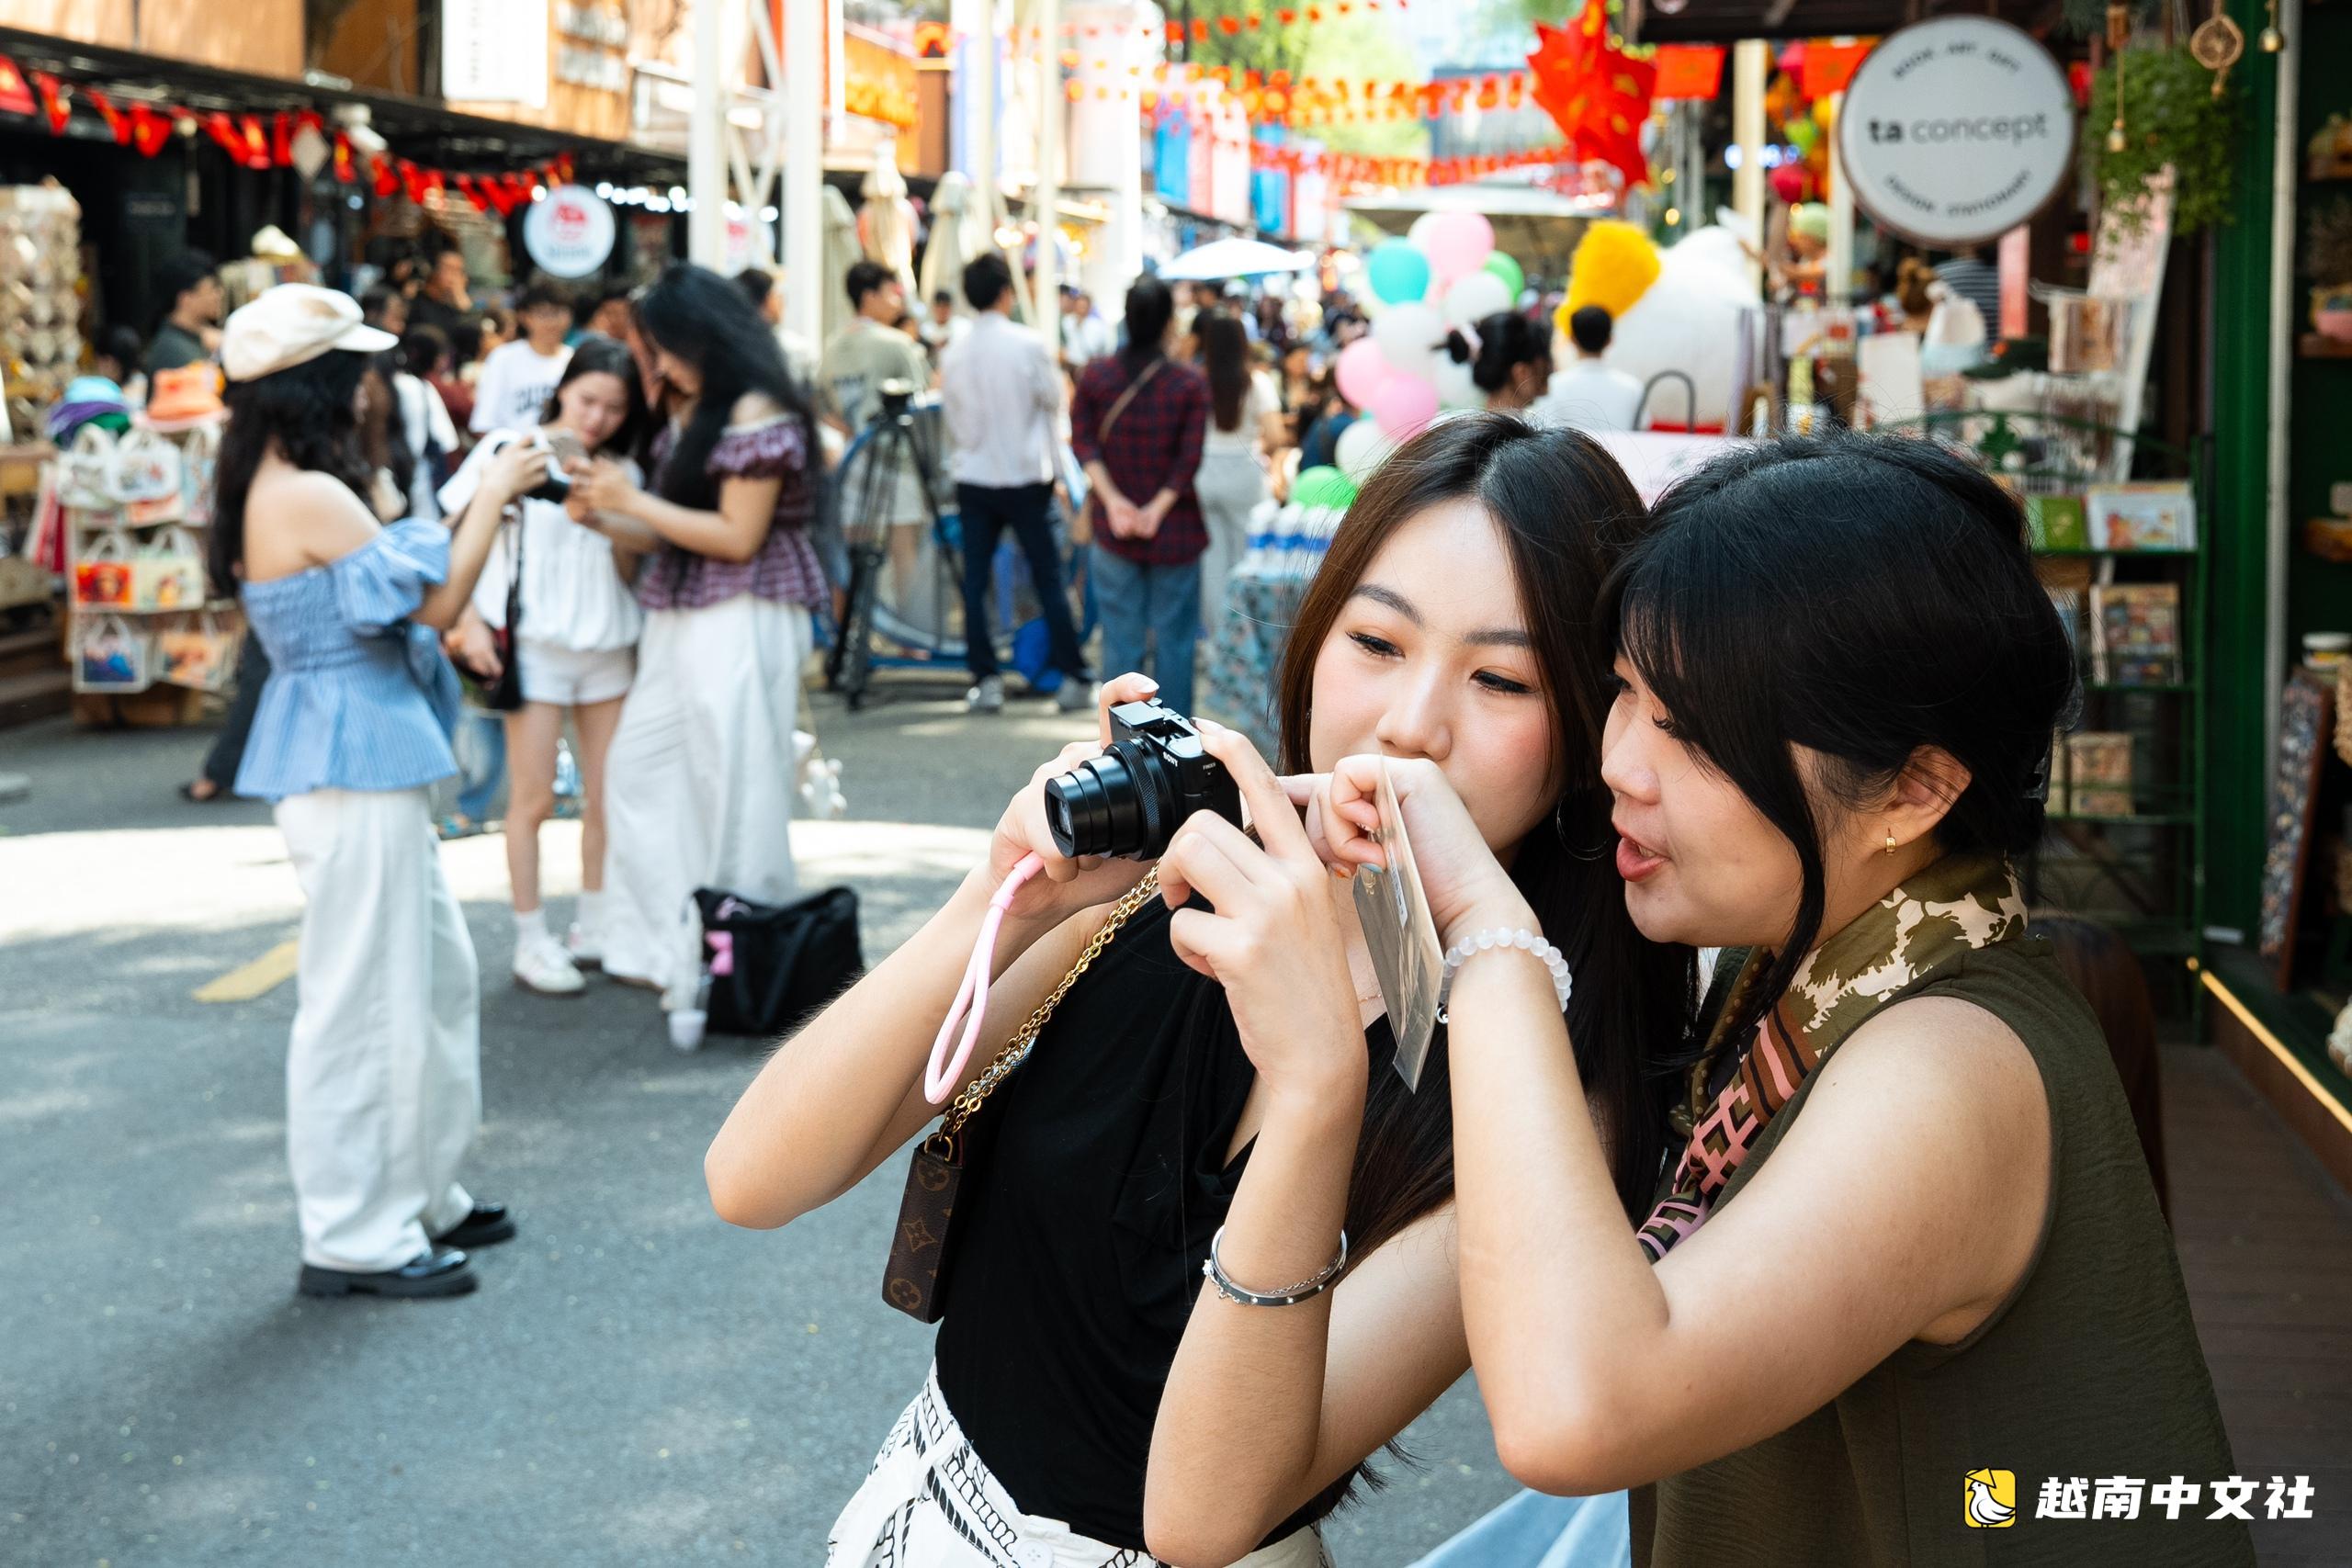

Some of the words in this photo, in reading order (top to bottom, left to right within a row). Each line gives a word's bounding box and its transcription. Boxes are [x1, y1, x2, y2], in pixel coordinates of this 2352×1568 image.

[1869, 118, 1903, 142] ta
[1911, 112, 2047, 144] concept
[1162, 751, 1178, 767] SONY
